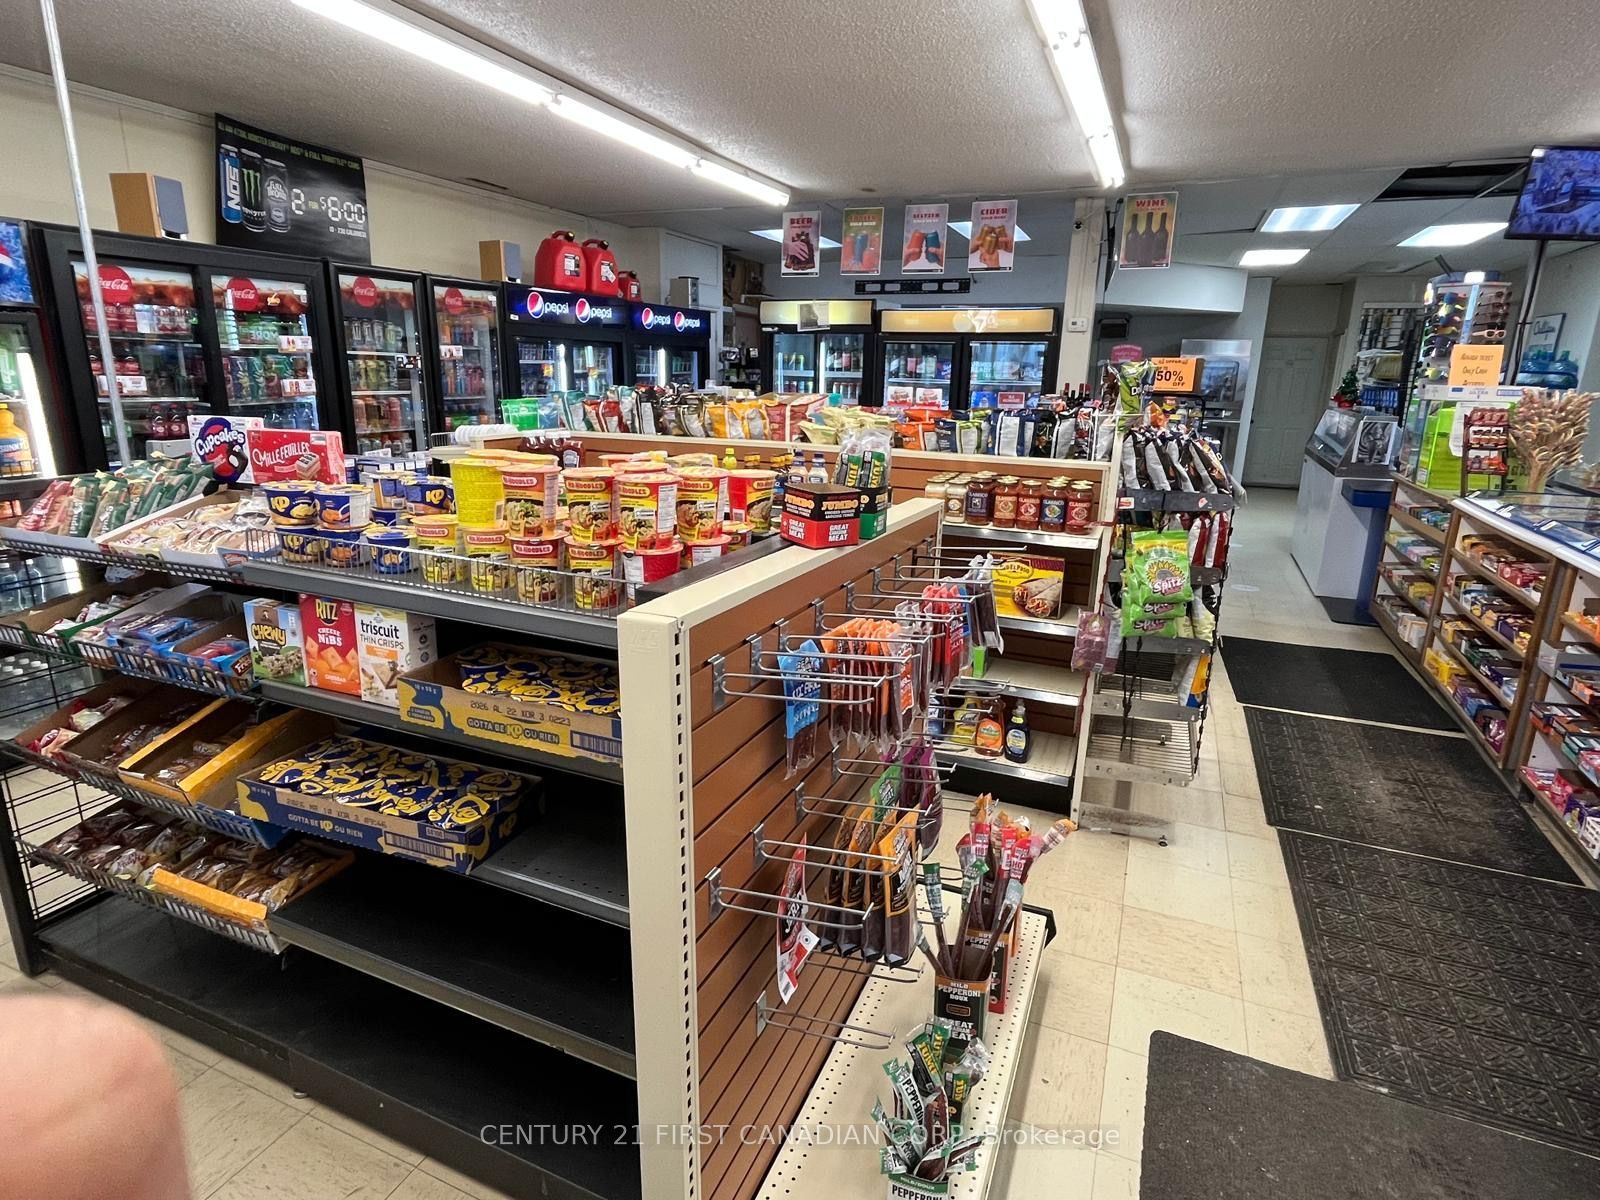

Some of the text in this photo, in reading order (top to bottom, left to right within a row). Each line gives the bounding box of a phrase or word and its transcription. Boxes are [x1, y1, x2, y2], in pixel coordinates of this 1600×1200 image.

[225, 159, 241, 210] NOS
[291, 188, 305, 215] 2
[1136, 199, 1167, 208] WINE
[981, 207, 1008, 216] CIDER
[790, 217, 812, 225] BEER
[544, 302, 569, 315] pepsi
[591, 306, 612, 320] pepsi
[653, 314, 671, 326] pepsi
[684, 317, 700, 328] pepsi
[1156, 370, 1183, 381] 50%
[195, 429, 245, 455] Cupcakes
[829, 534, 848, 542] MEAT
[1153, 577, 1184, 594] Spitz
[315, 599, 338, 621] RITZ
[317, 627, 341, 637] CHEESE
[361, 619, 400, 640] triscuit
[360, 633, 404, 650] THIN CRISPS
[470, 700, 488, 711] 2026
[506, 707, 517, 716] 22
[539, 711, 545, 721] 3
[467, 717, 494, 731] GOTTA
[494, 722, 505, 733] BE
[524, 729, 538, 740] OU
[538, 731, 560, 745] RIEN
[288, 813, 310, 826] GOTTA
[311, 818, 319, 827] BE
[334, 825, 345, 834] OU
[346, 827, 363, 839] RIEN
[938, 984, 981, 998] PEPPERONI
